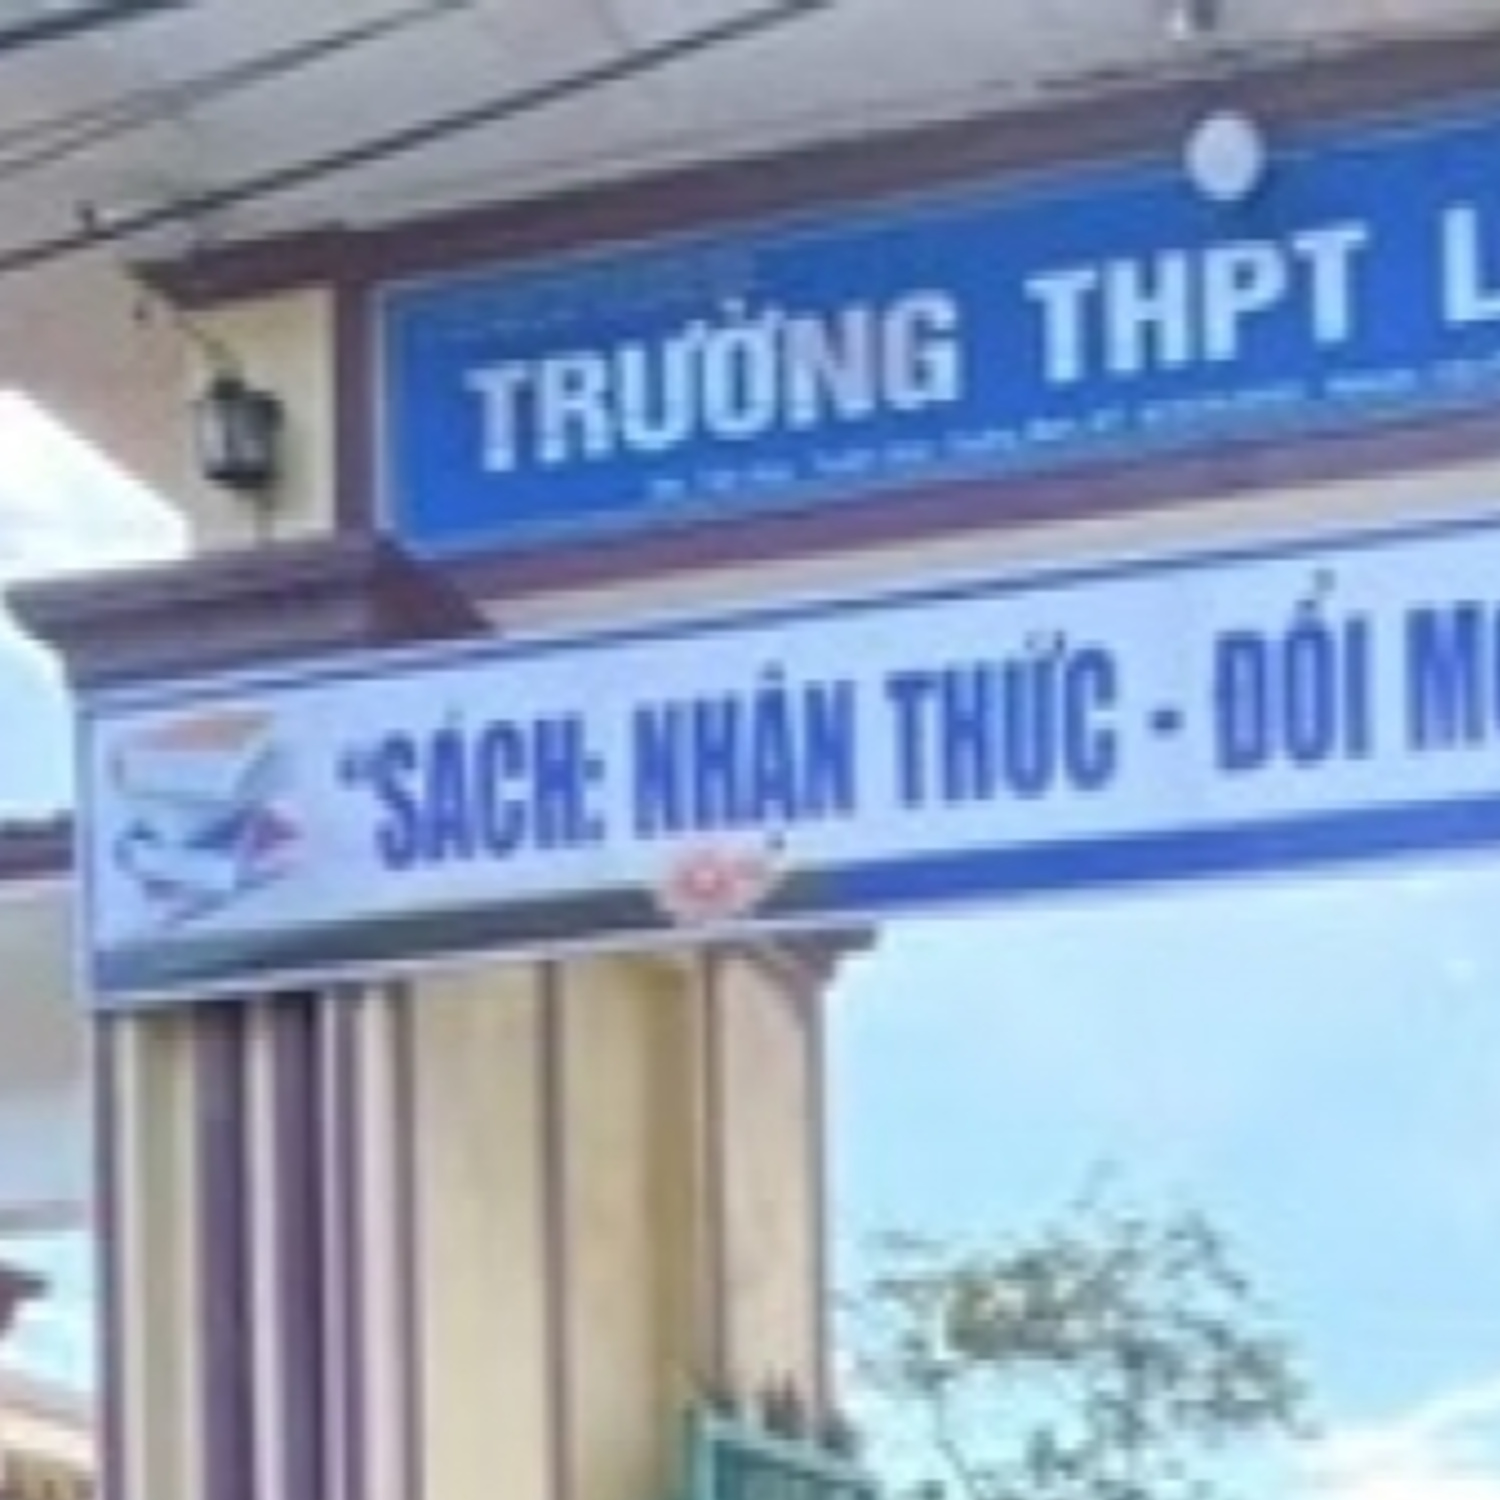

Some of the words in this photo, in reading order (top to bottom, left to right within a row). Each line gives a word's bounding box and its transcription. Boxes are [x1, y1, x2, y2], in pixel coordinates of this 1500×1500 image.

[465, 290, 962, 472] TRƯỜNG
[1024, 224, 1368, 382] THPT
[632, 662, 858, 852] NHẬN
[885, 632, 1119, 804] THỨC
[1214, 570, 1371, 771] ĐỔI
